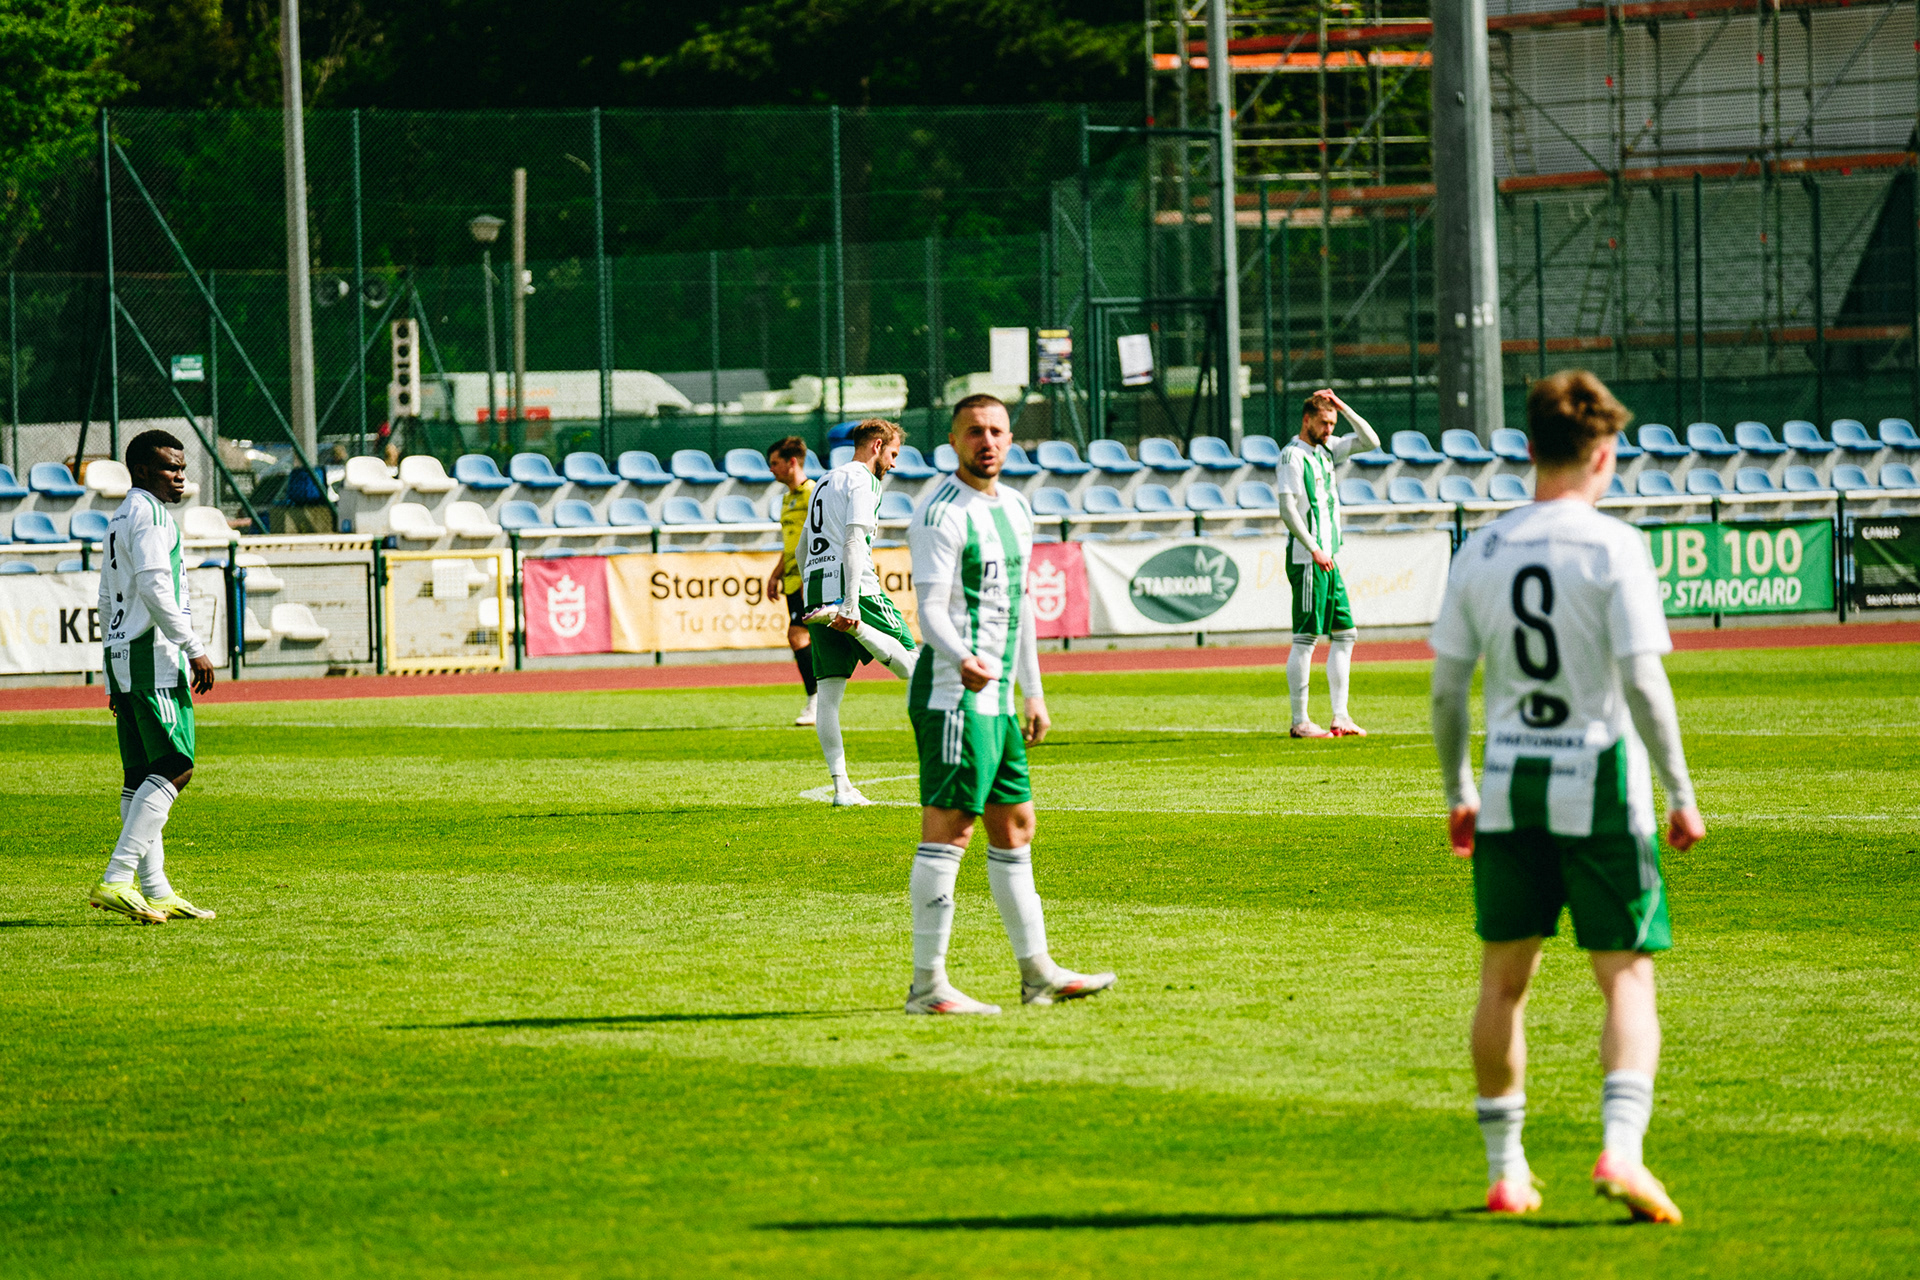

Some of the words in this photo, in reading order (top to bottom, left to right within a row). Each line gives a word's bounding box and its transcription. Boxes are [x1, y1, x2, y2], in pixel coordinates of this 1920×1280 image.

[810, 480, 830, 534] 6
[1723, 527, 1803, 576] 100
[1132, 576, 1212, 598] STARKOM
[1674, 577, 1802, 608] STAROGARD
[676, 611, 703, 633] Tu
